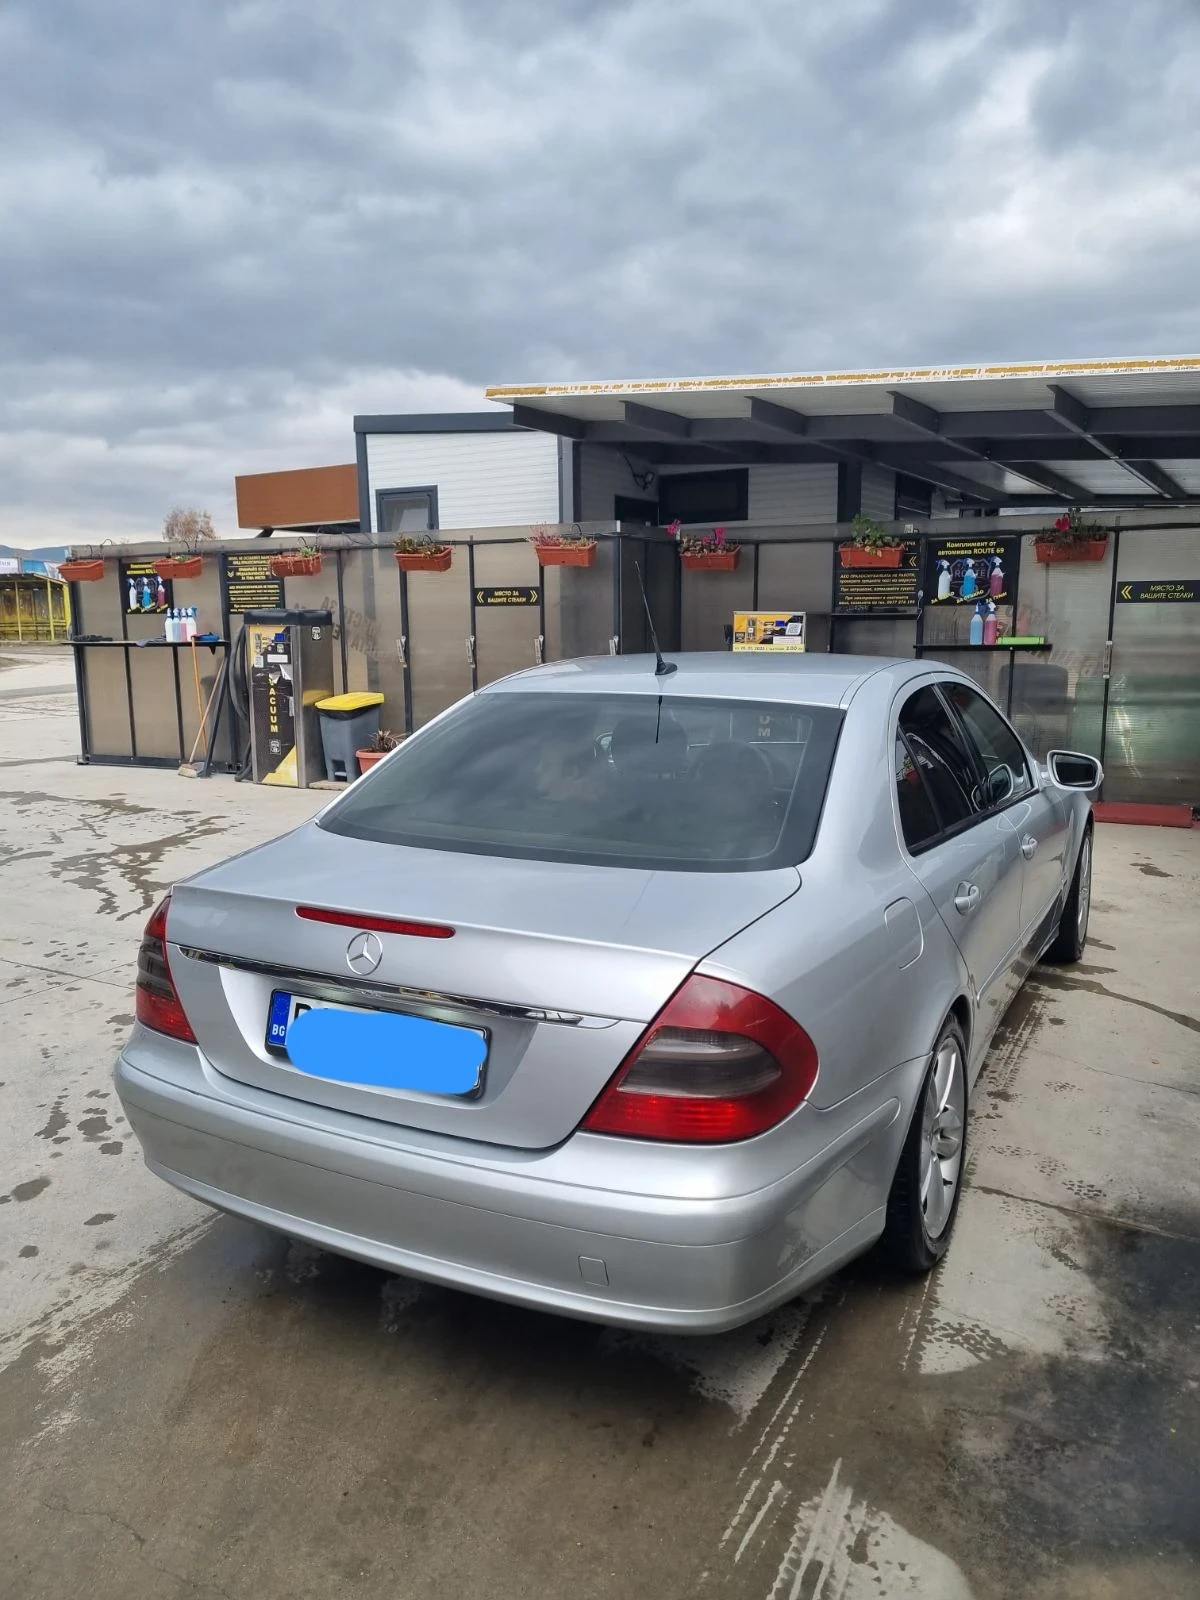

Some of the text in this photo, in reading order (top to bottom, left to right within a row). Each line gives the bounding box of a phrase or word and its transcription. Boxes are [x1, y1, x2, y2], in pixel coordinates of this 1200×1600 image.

[973, 547, 995, 555] ROUTE
[1149, 584, 1175, 592] МЯСТО
[268, 678, 279, 733] VACUUM
[272, 1023, 286, 1037] BG
